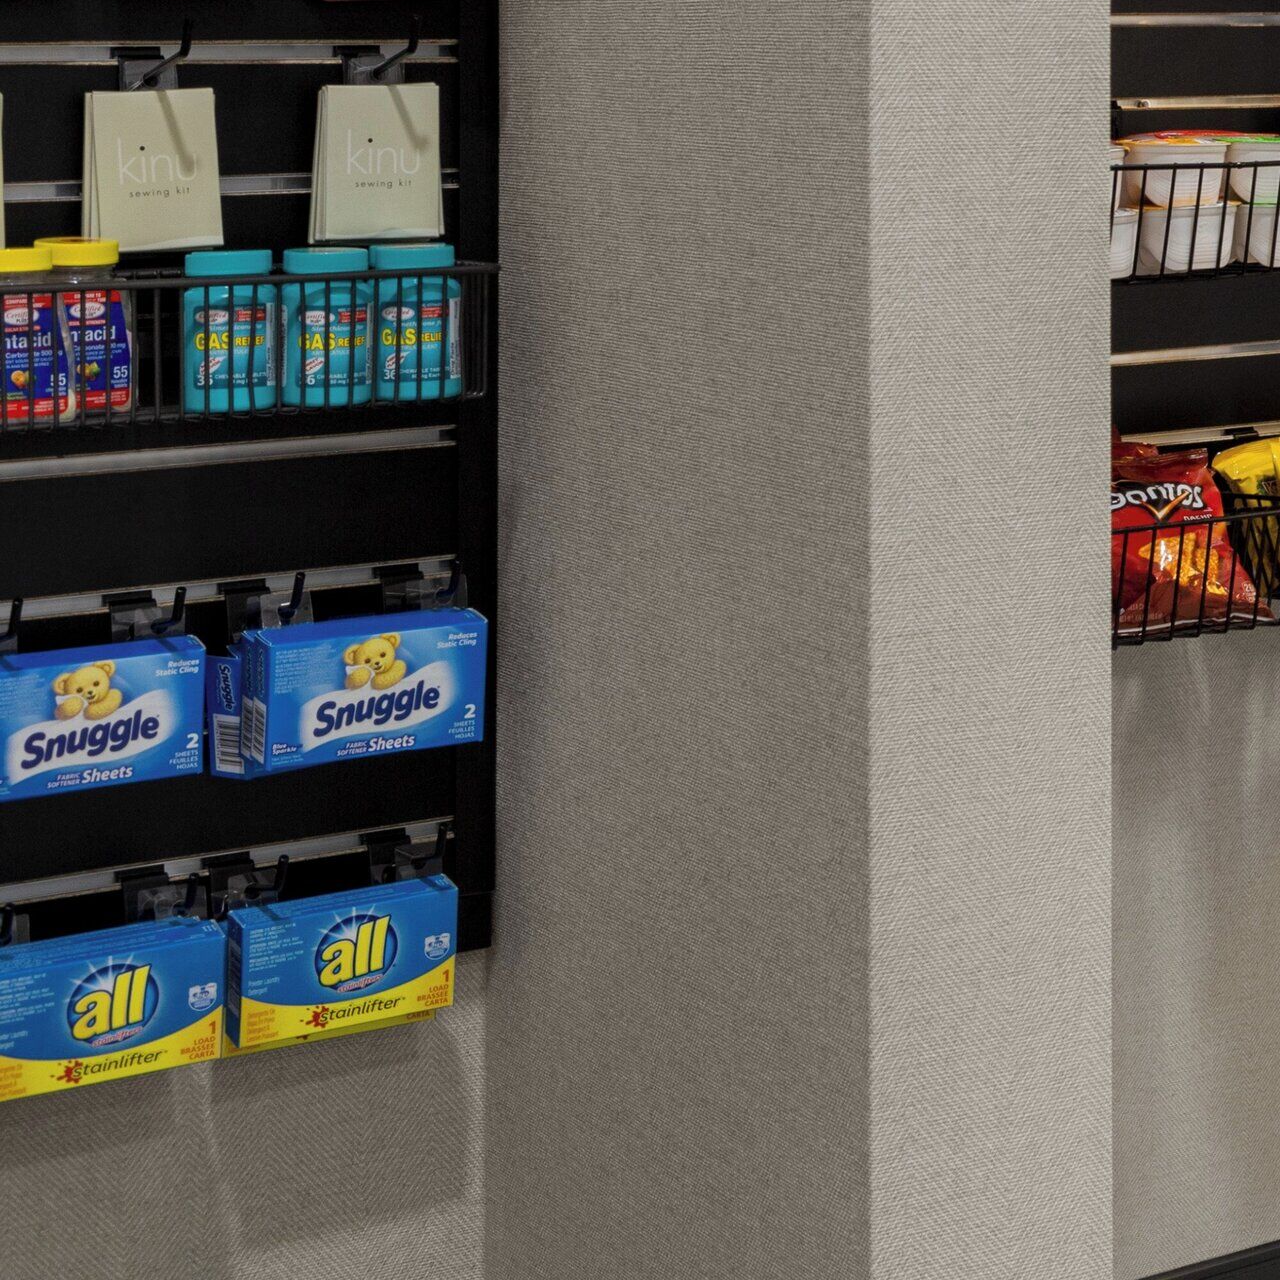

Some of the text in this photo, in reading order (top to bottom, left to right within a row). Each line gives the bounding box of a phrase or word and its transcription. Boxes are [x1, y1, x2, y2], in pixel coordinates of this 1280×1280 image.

[346, 129, 421, 176] kinu
[116, 136, 198, 186] kinu
[354, 178, 412, 190] sewing kit
[129, 186, 191, 199] sewing kit
[113, 366, 128, 378] 55
[436, 637, 477, 648] Static Cling
[448, 632, 477, 643] Reduces
[155, 664, 200, 677] Static Cling
[168, 658, 200, 669] Reduces
[312, 680, 441, 737] Snuggle
[464, 704, 476, 719] 2
[20, 708, 159, 770] Snuggle
[186, 733, 199, 749] 2
[368, 734, 415, 752] Sheets
[174, 748, 199, 758] SHEETS
[81, 764, 133, 784] Sheets
[317, 914, 391, 987] all
[429, 985, 449, 994] LOAD
[70, 964, 153, 1041] all
[320, 996, 402, 1023] stainlifter
[193, 1035, 216, 1045] LOAD
[72, 1049, 162, 1081] stainlifter
